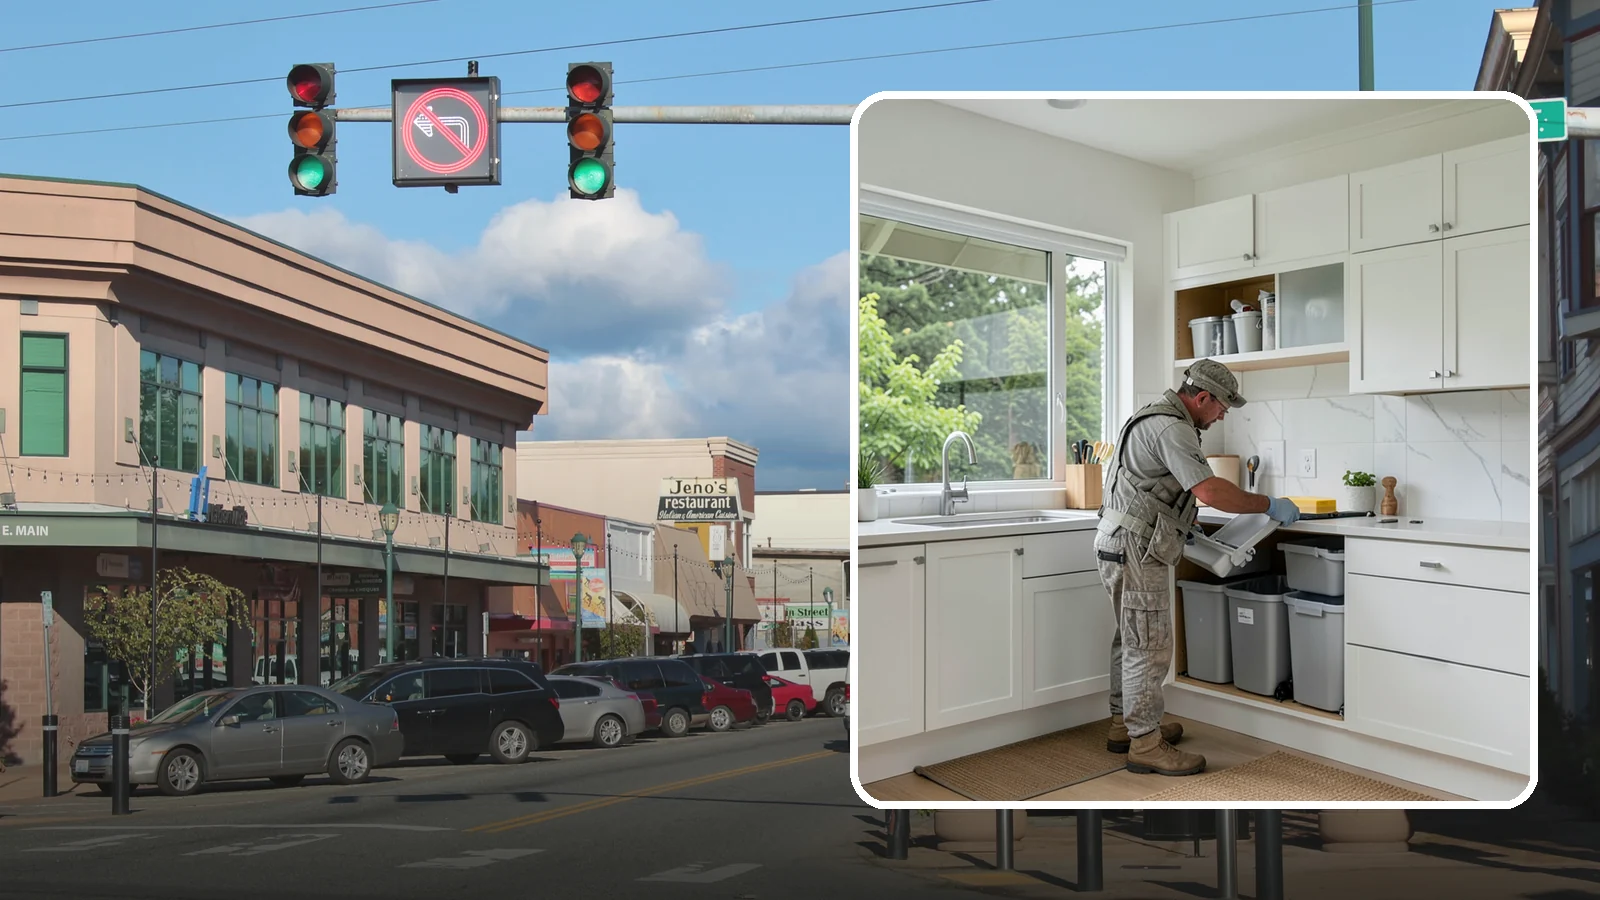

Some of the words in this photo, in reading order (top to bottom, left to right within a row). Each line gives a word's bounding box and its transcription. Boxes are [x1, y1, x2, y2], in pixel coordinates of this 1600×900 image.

[669, 480, 728, 494] Jeno's
[664, 496, 731, 509] restaurant
[686, 509, 715, 519] American
[715, 509, 738, 519] Cuisine
[2, 525, 13, 536] E.
[15, 525, 49, 536] MAIN
[797, 607, 828, 617] Street
